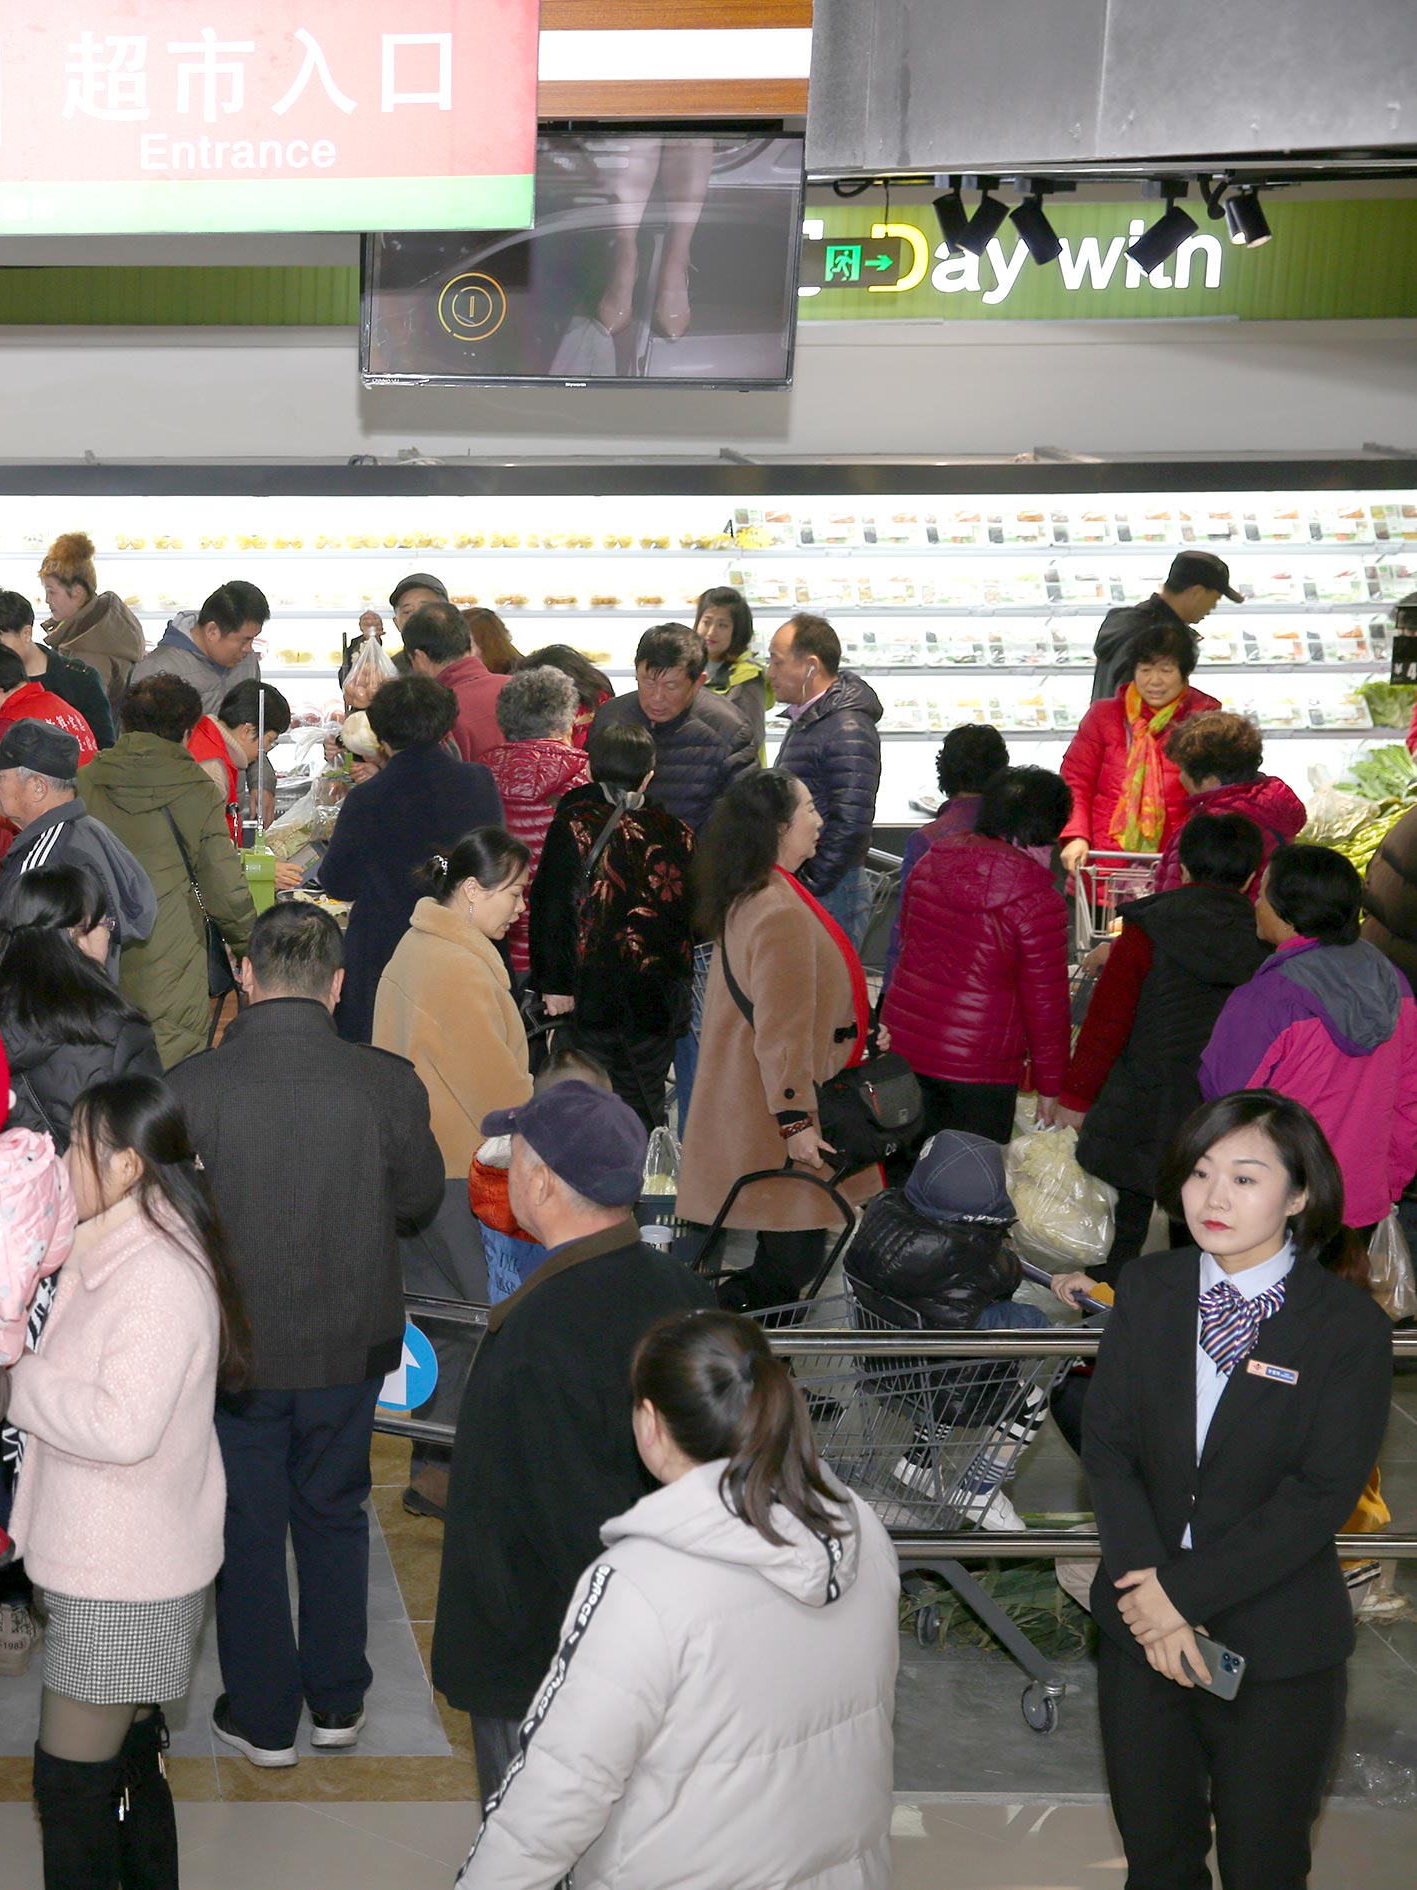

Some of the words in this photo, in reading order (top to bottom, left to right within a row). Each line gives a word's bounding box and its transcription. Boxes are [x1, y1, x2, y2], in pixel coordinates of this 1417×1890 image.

[60, 27, 454, 123] 超市入口
[140, 133, 337, 171] Entrance
[867, 223, 1029, 304] Day
